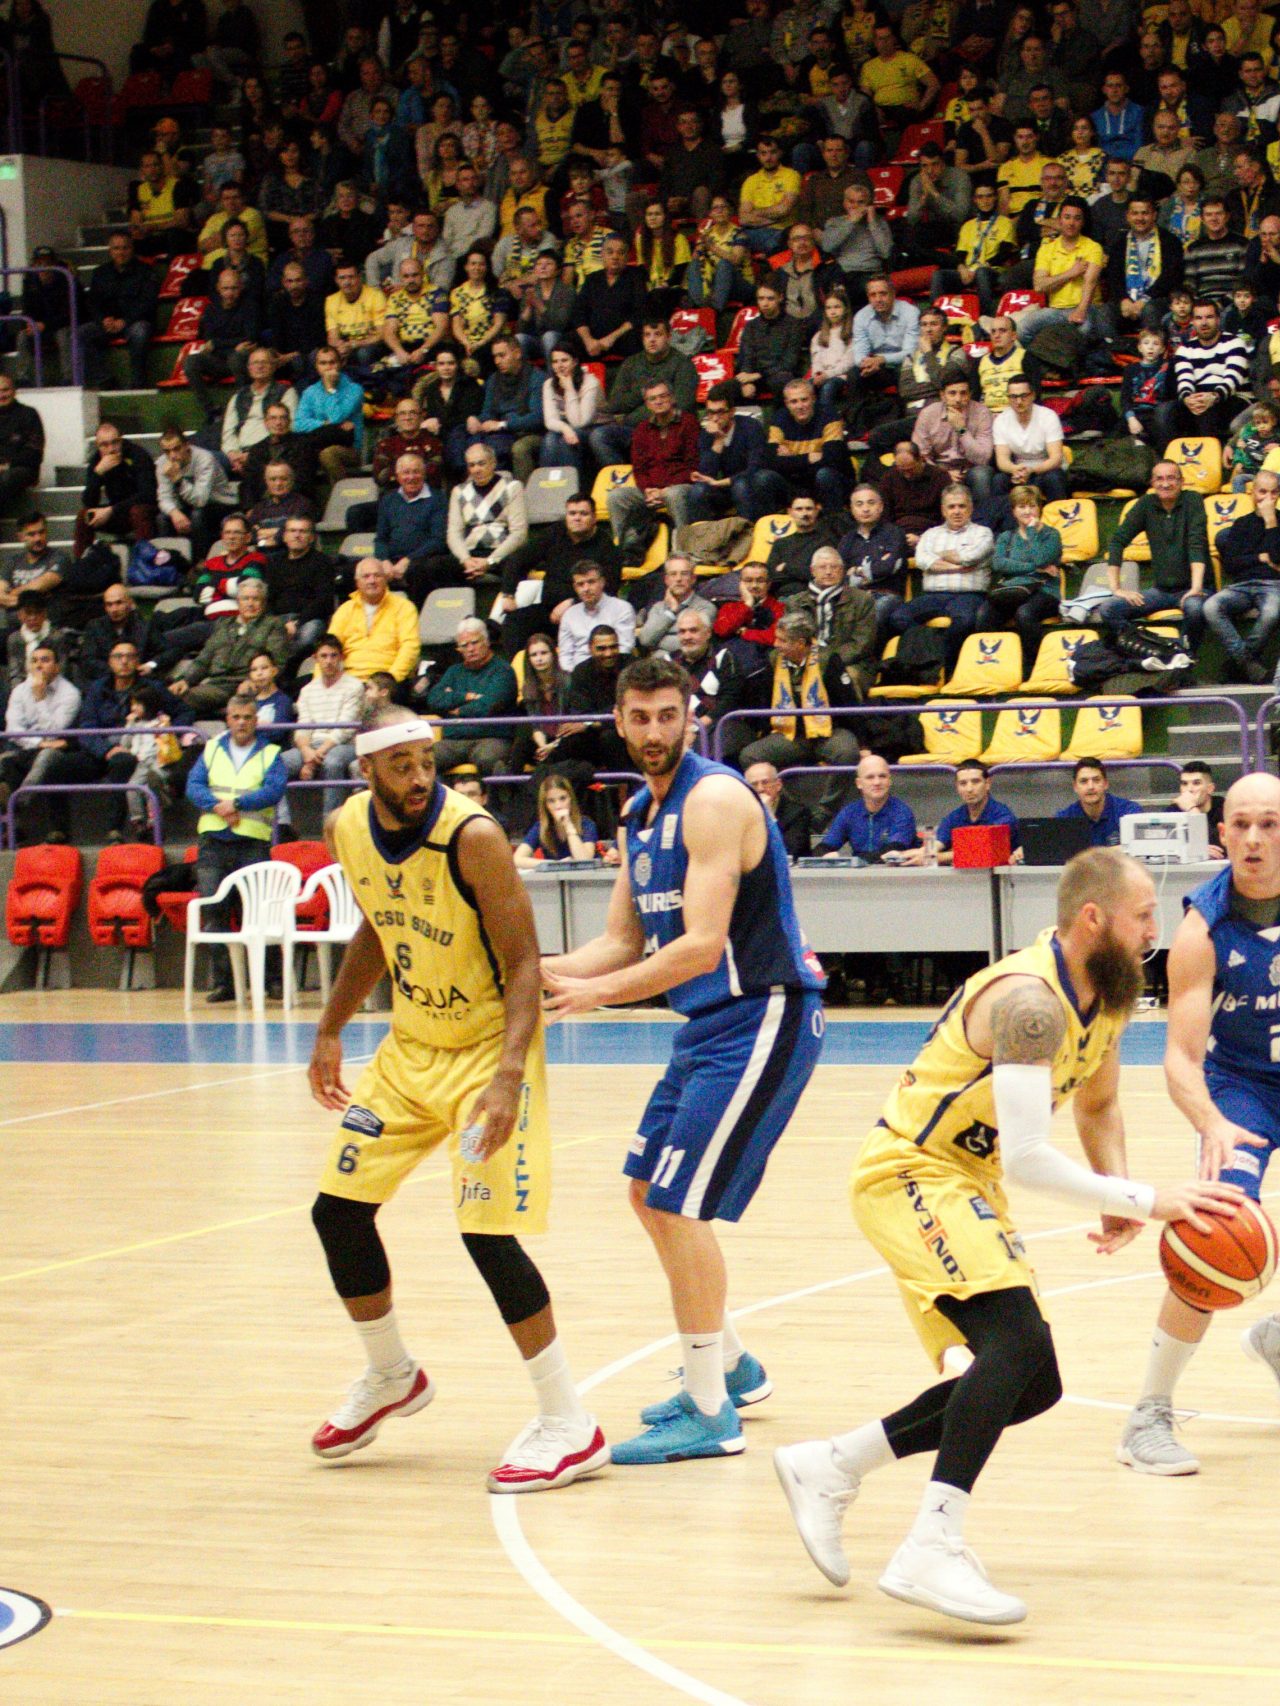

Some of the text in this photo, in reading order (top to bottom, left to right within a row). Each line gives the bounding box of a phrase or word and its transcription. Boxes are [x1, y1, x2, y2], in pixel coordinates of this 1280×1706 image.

[374, 910, 455, 947] CSU SIBIU
[395, 942, 412, 970] 6
[338, 1143, 361, 1175] 6
[651, 1145, 686, 1189] 11
[457, 1177, 491, 1208] jifa
